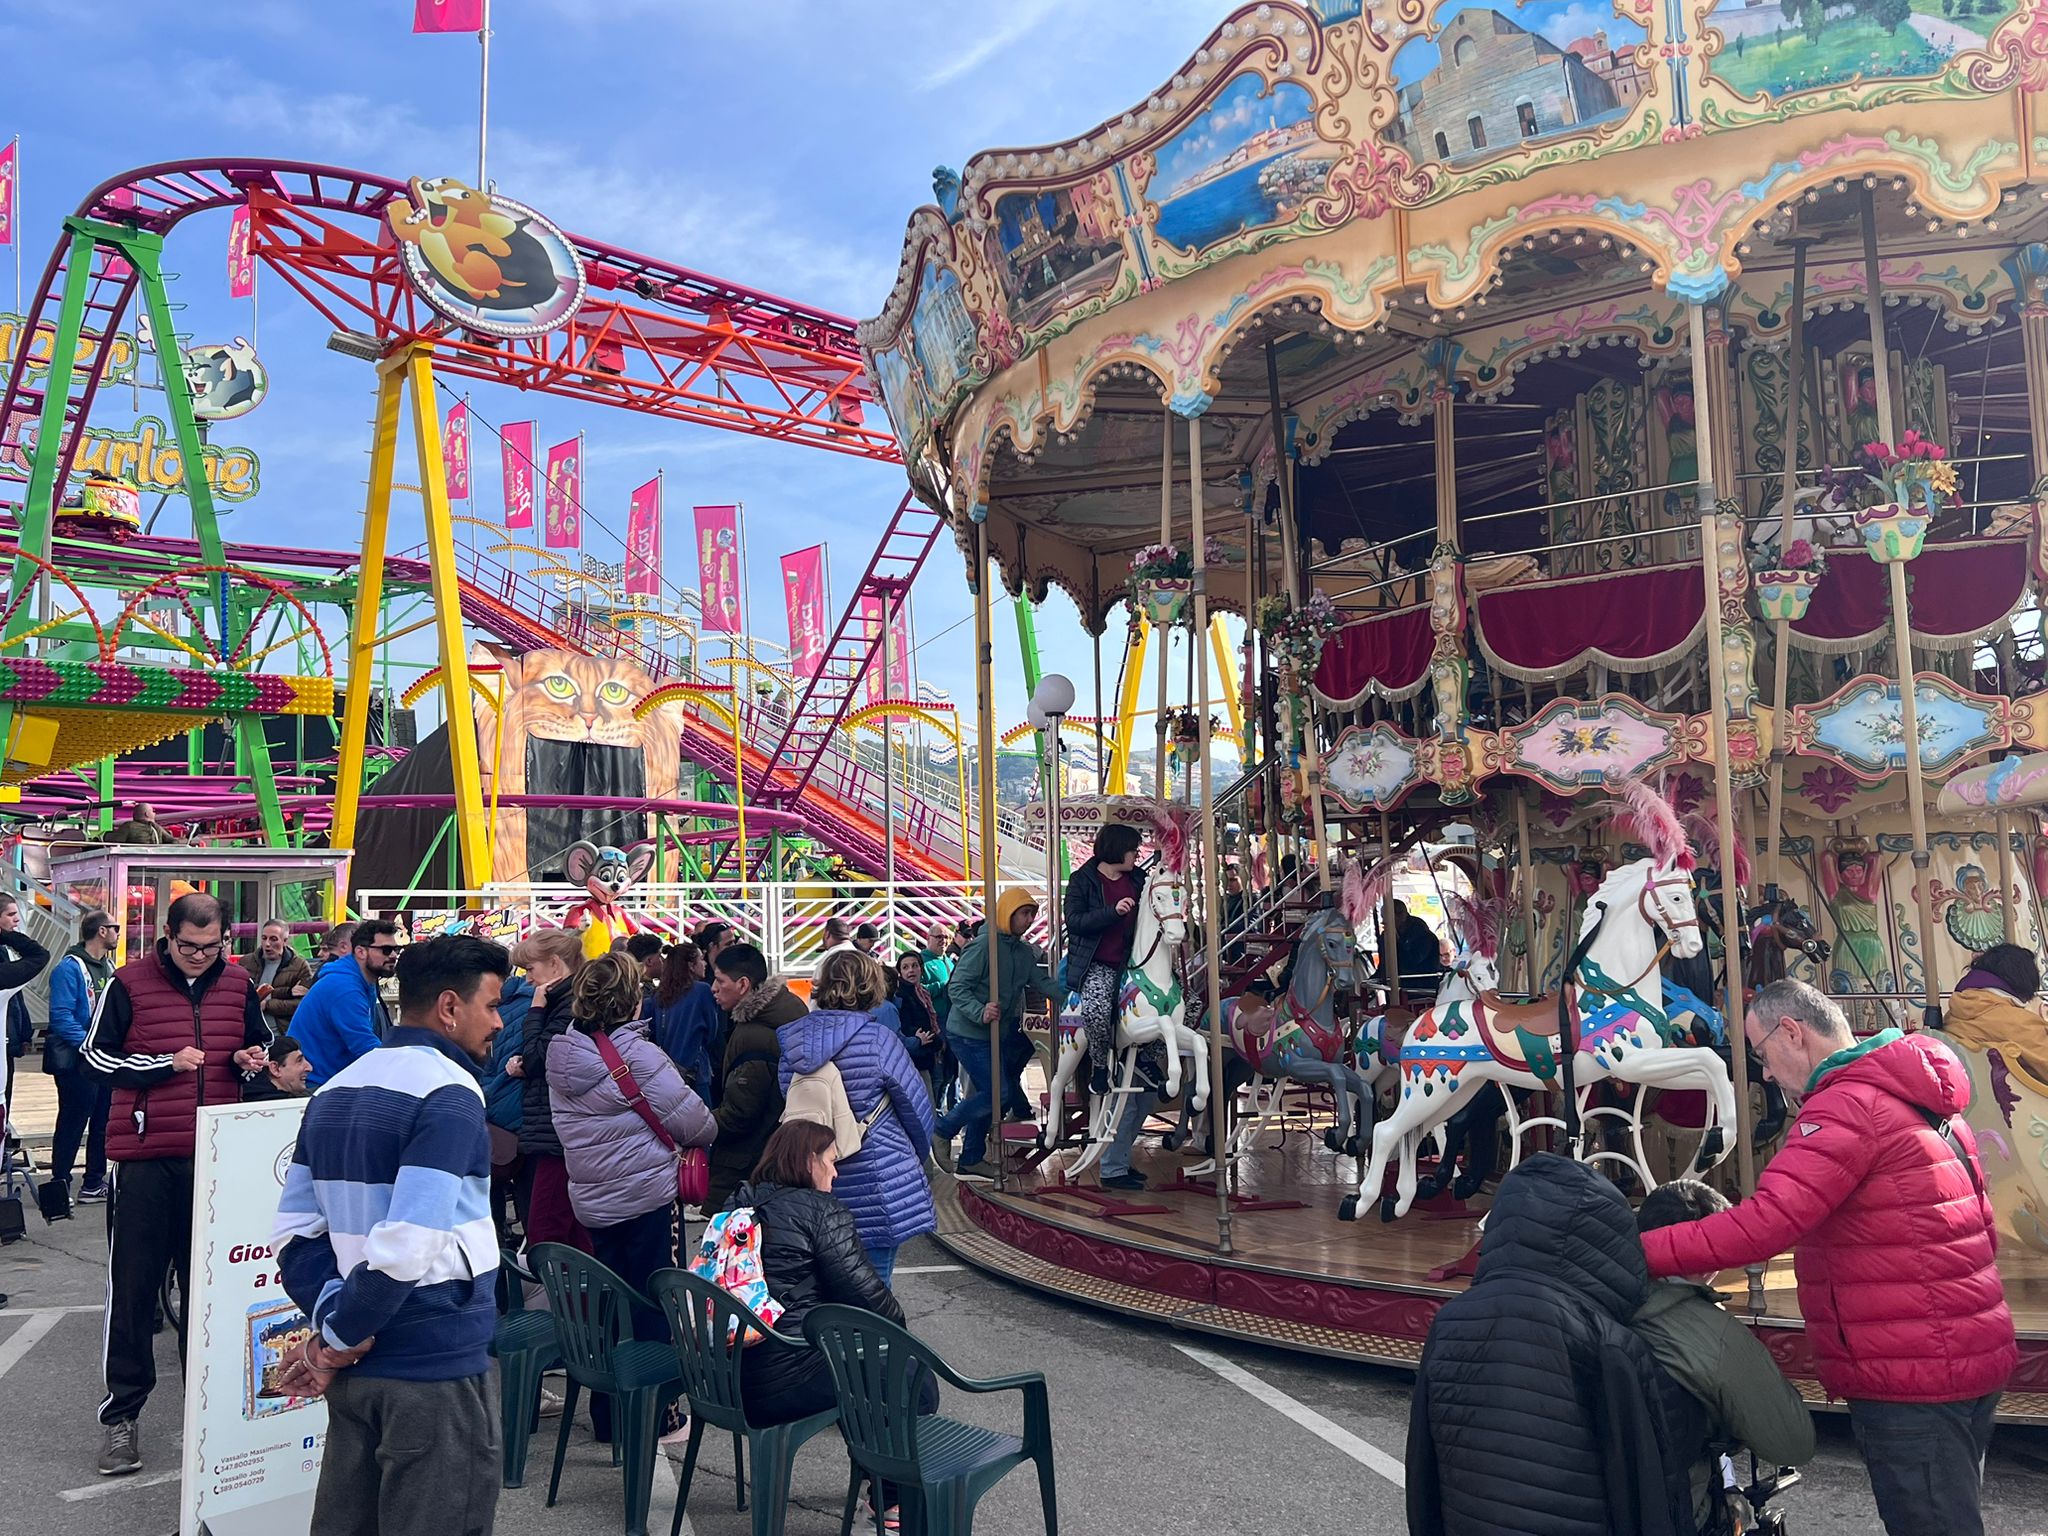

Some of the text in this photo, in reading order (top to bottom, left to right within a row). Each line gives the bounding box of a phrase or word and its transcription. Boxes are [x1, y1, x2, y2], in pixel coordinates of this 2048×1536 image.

[0, 322, 129, 379] per
[228, 1243, 273, 1264] Gios
[253, 1272, 267, 1288] a
[220, 1441, 292, 1464] Vassallo Massimiliano
[219, 1467, 266, 1484] Vassallo Jody
